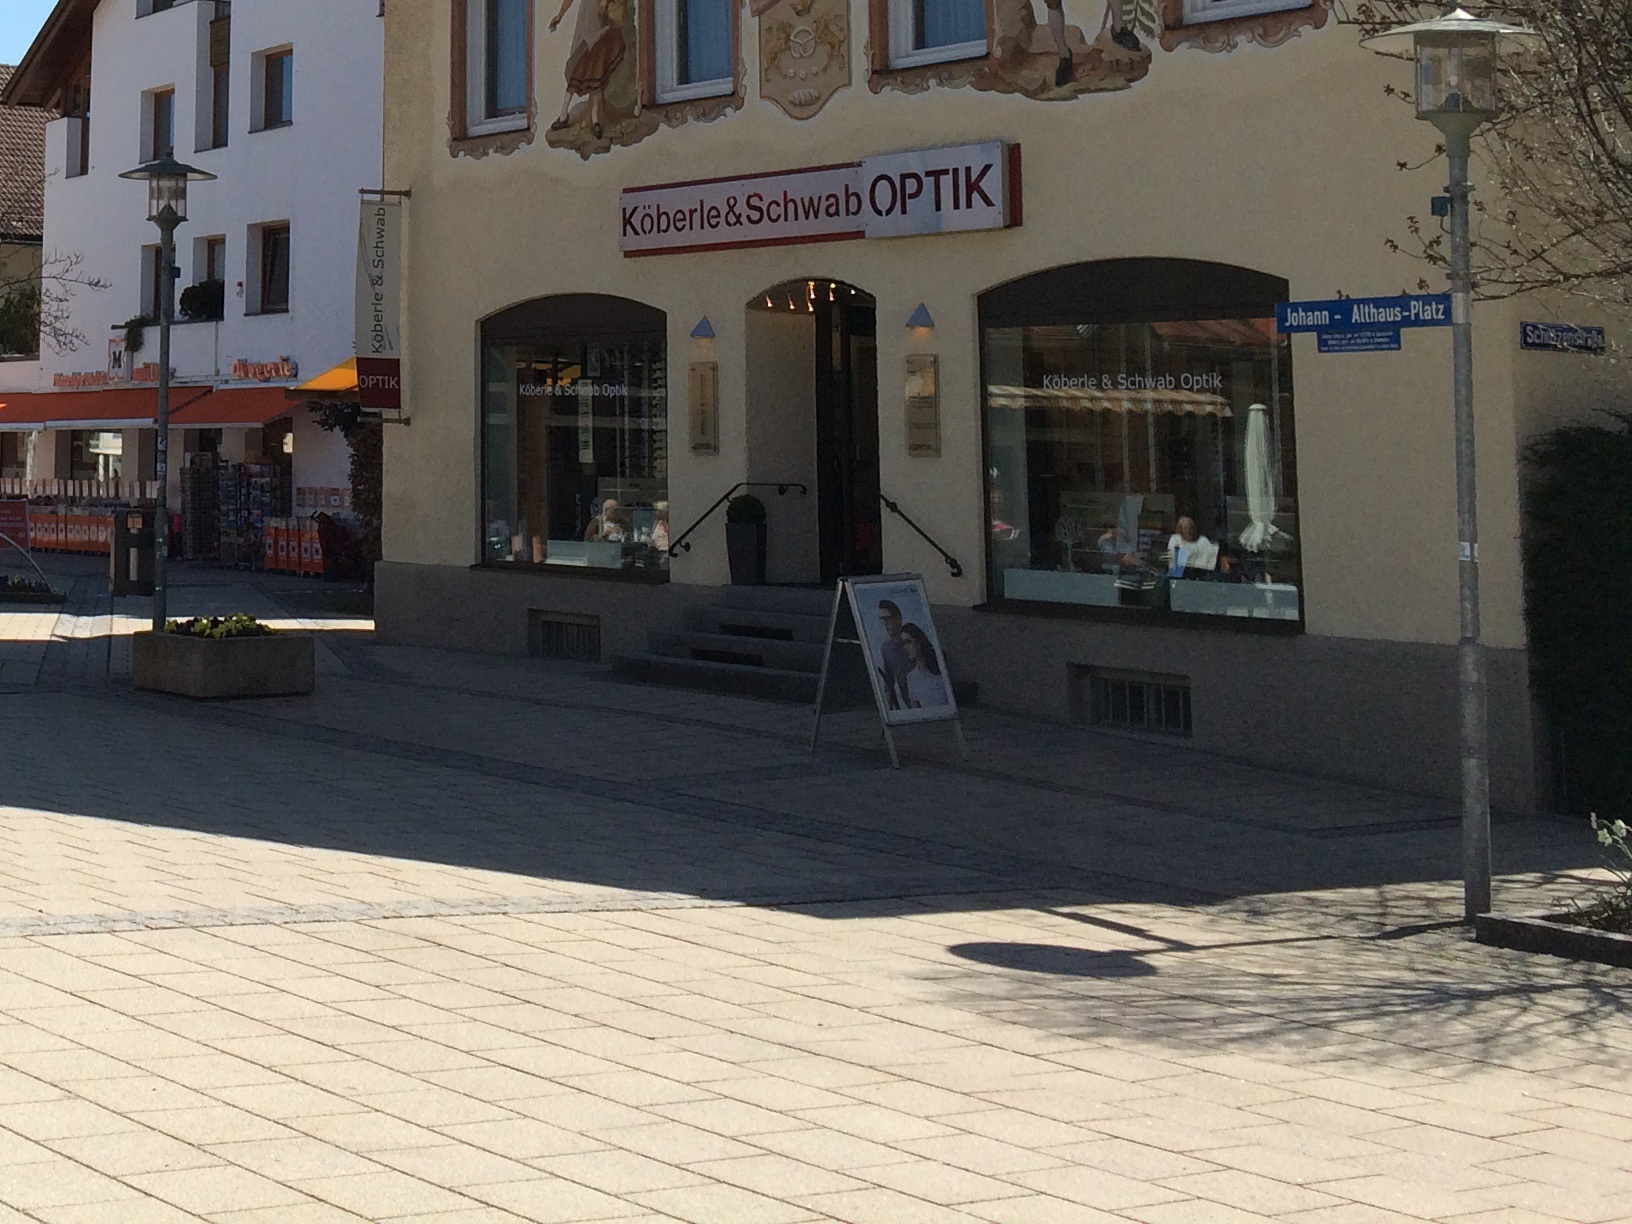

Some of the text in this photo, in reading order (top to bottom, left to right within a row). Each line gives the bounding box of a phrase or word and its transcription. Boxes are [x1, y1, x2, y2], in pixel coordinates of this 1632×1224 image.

[621, 164, 996, 237] Köberle&Schwab OPTIK
[371, 207, 386, 354] Köberle & Schwab
[1285, 308, 1330, 327] Johann
[1351, 300, 1445, 324] Althaus-Platz
[112, 350, 122, 369] M
[359, 375, 399, 389] OPTIK
[519, 383, 553, 397] Köberle
[554, 383, 562, 397] &
[602, 384, 628, 399] Optik
[1043, 373, 1223, 392] Köberle & Schwab Optik
